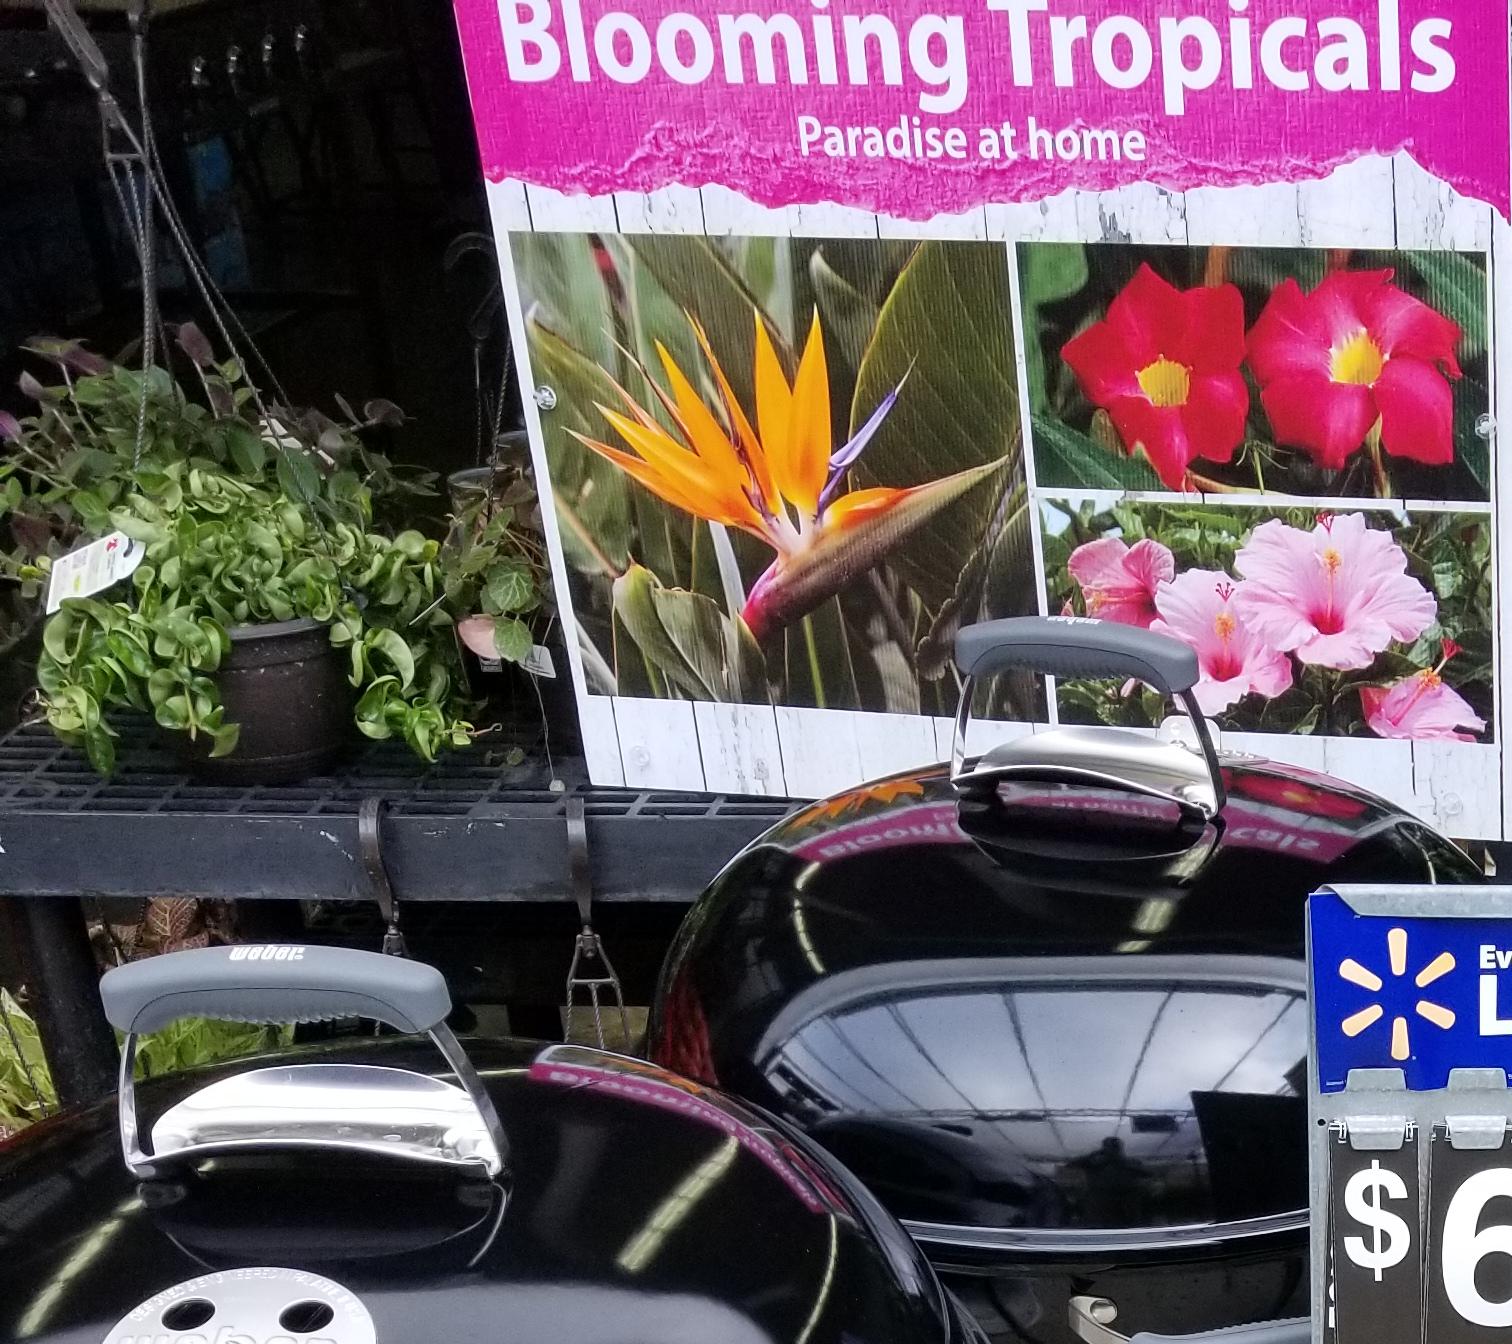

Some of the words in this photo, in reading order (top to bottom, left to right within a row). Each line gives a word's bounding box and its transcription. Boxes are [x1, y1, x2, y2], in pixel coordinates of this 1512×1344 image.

[498, 0, 968, 114] Blooming
[988, 0, 1456, 116] Tropicals
[798, 115, 967, 158] Paradise
[978, 124, 1017, 158] at
[1028, 117, 1146, 161] home
